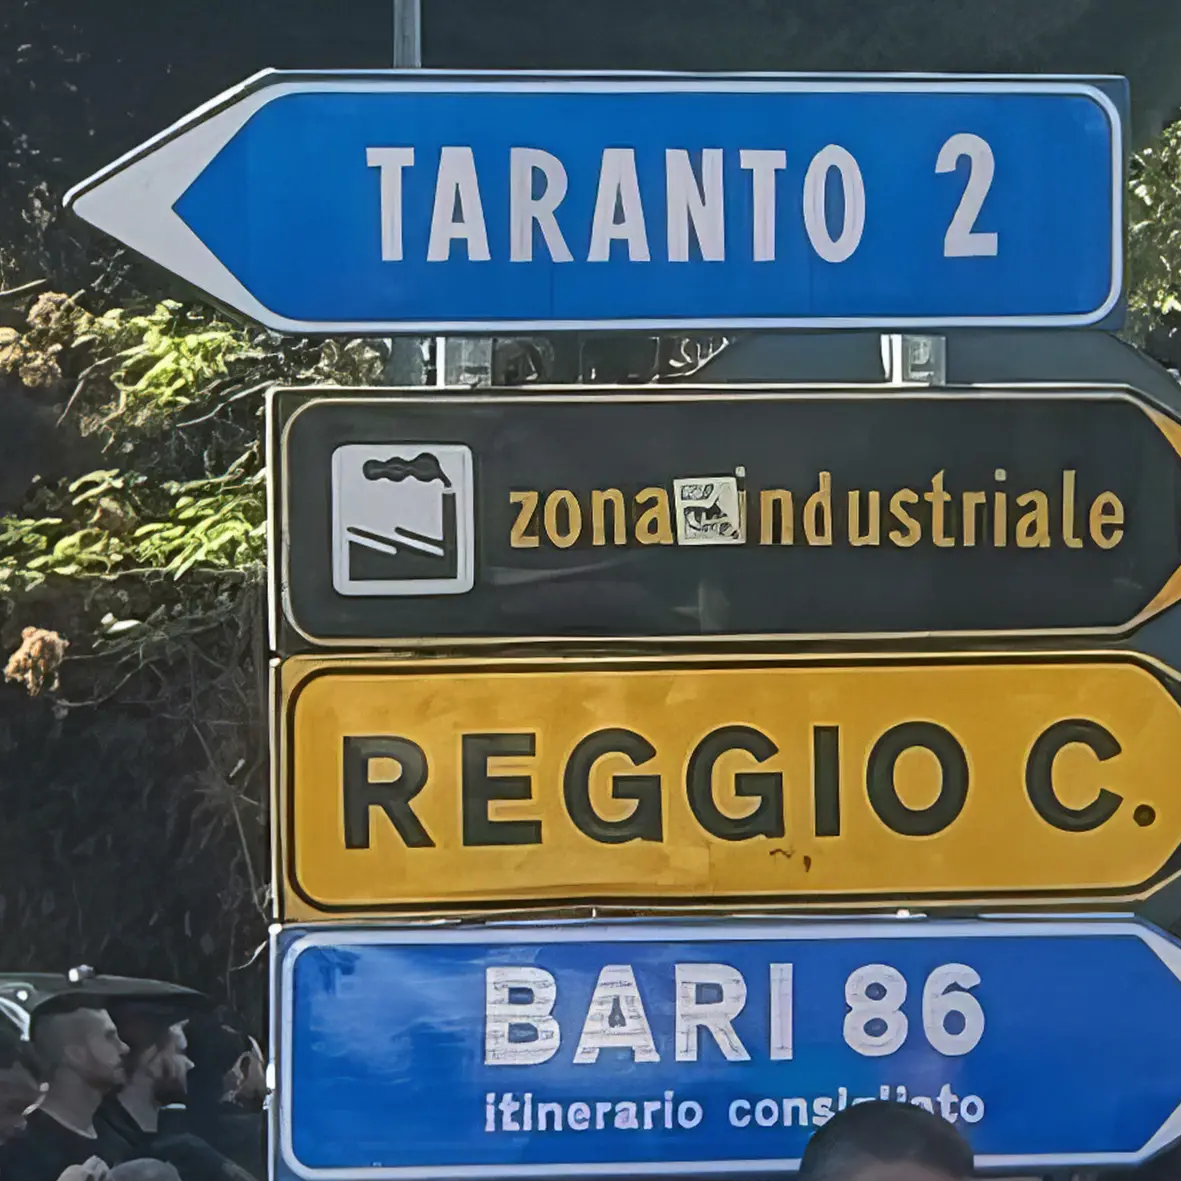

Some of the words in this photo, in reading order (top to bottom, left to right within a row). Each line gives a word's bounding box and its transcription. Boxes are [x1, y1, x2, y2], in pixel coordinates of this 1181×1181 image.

[366, 143, 866, 264] TARANTO
[934, 132, 999, 258] 2
[509, 485, 674, 549] zona
[734, 466, 1126, 550] industriale
[341, 720, 971, 850] REGGIO
[1024, 718, 1157, 833] C.
[484, 963, 794, 1066] BARI
[842, 962, 986, 1057] 86
[485, 1090, 704, 1133] itinerario
